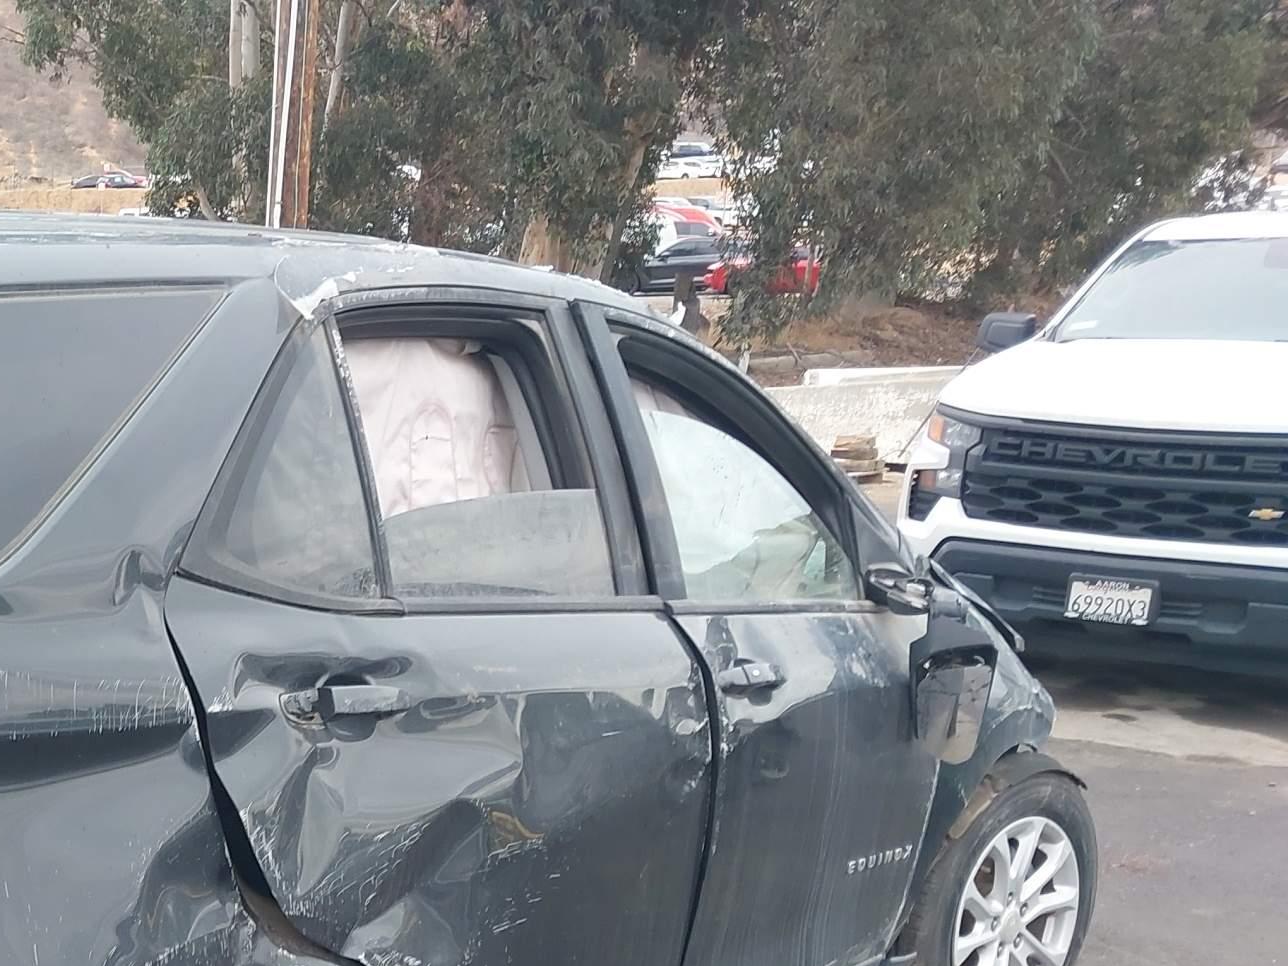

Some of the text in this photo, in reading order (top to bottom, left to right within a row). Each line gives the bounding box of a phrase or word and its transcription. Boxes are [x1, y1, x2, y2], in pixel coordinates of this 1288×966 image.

[991, 437, 1288, 474] CHEVROLE
[1071, 593, 1147, 620] 69920X3
[1081, 612, 1132, 625] CHEVROLET
[847, 844, 913, 874] EQUINOX
